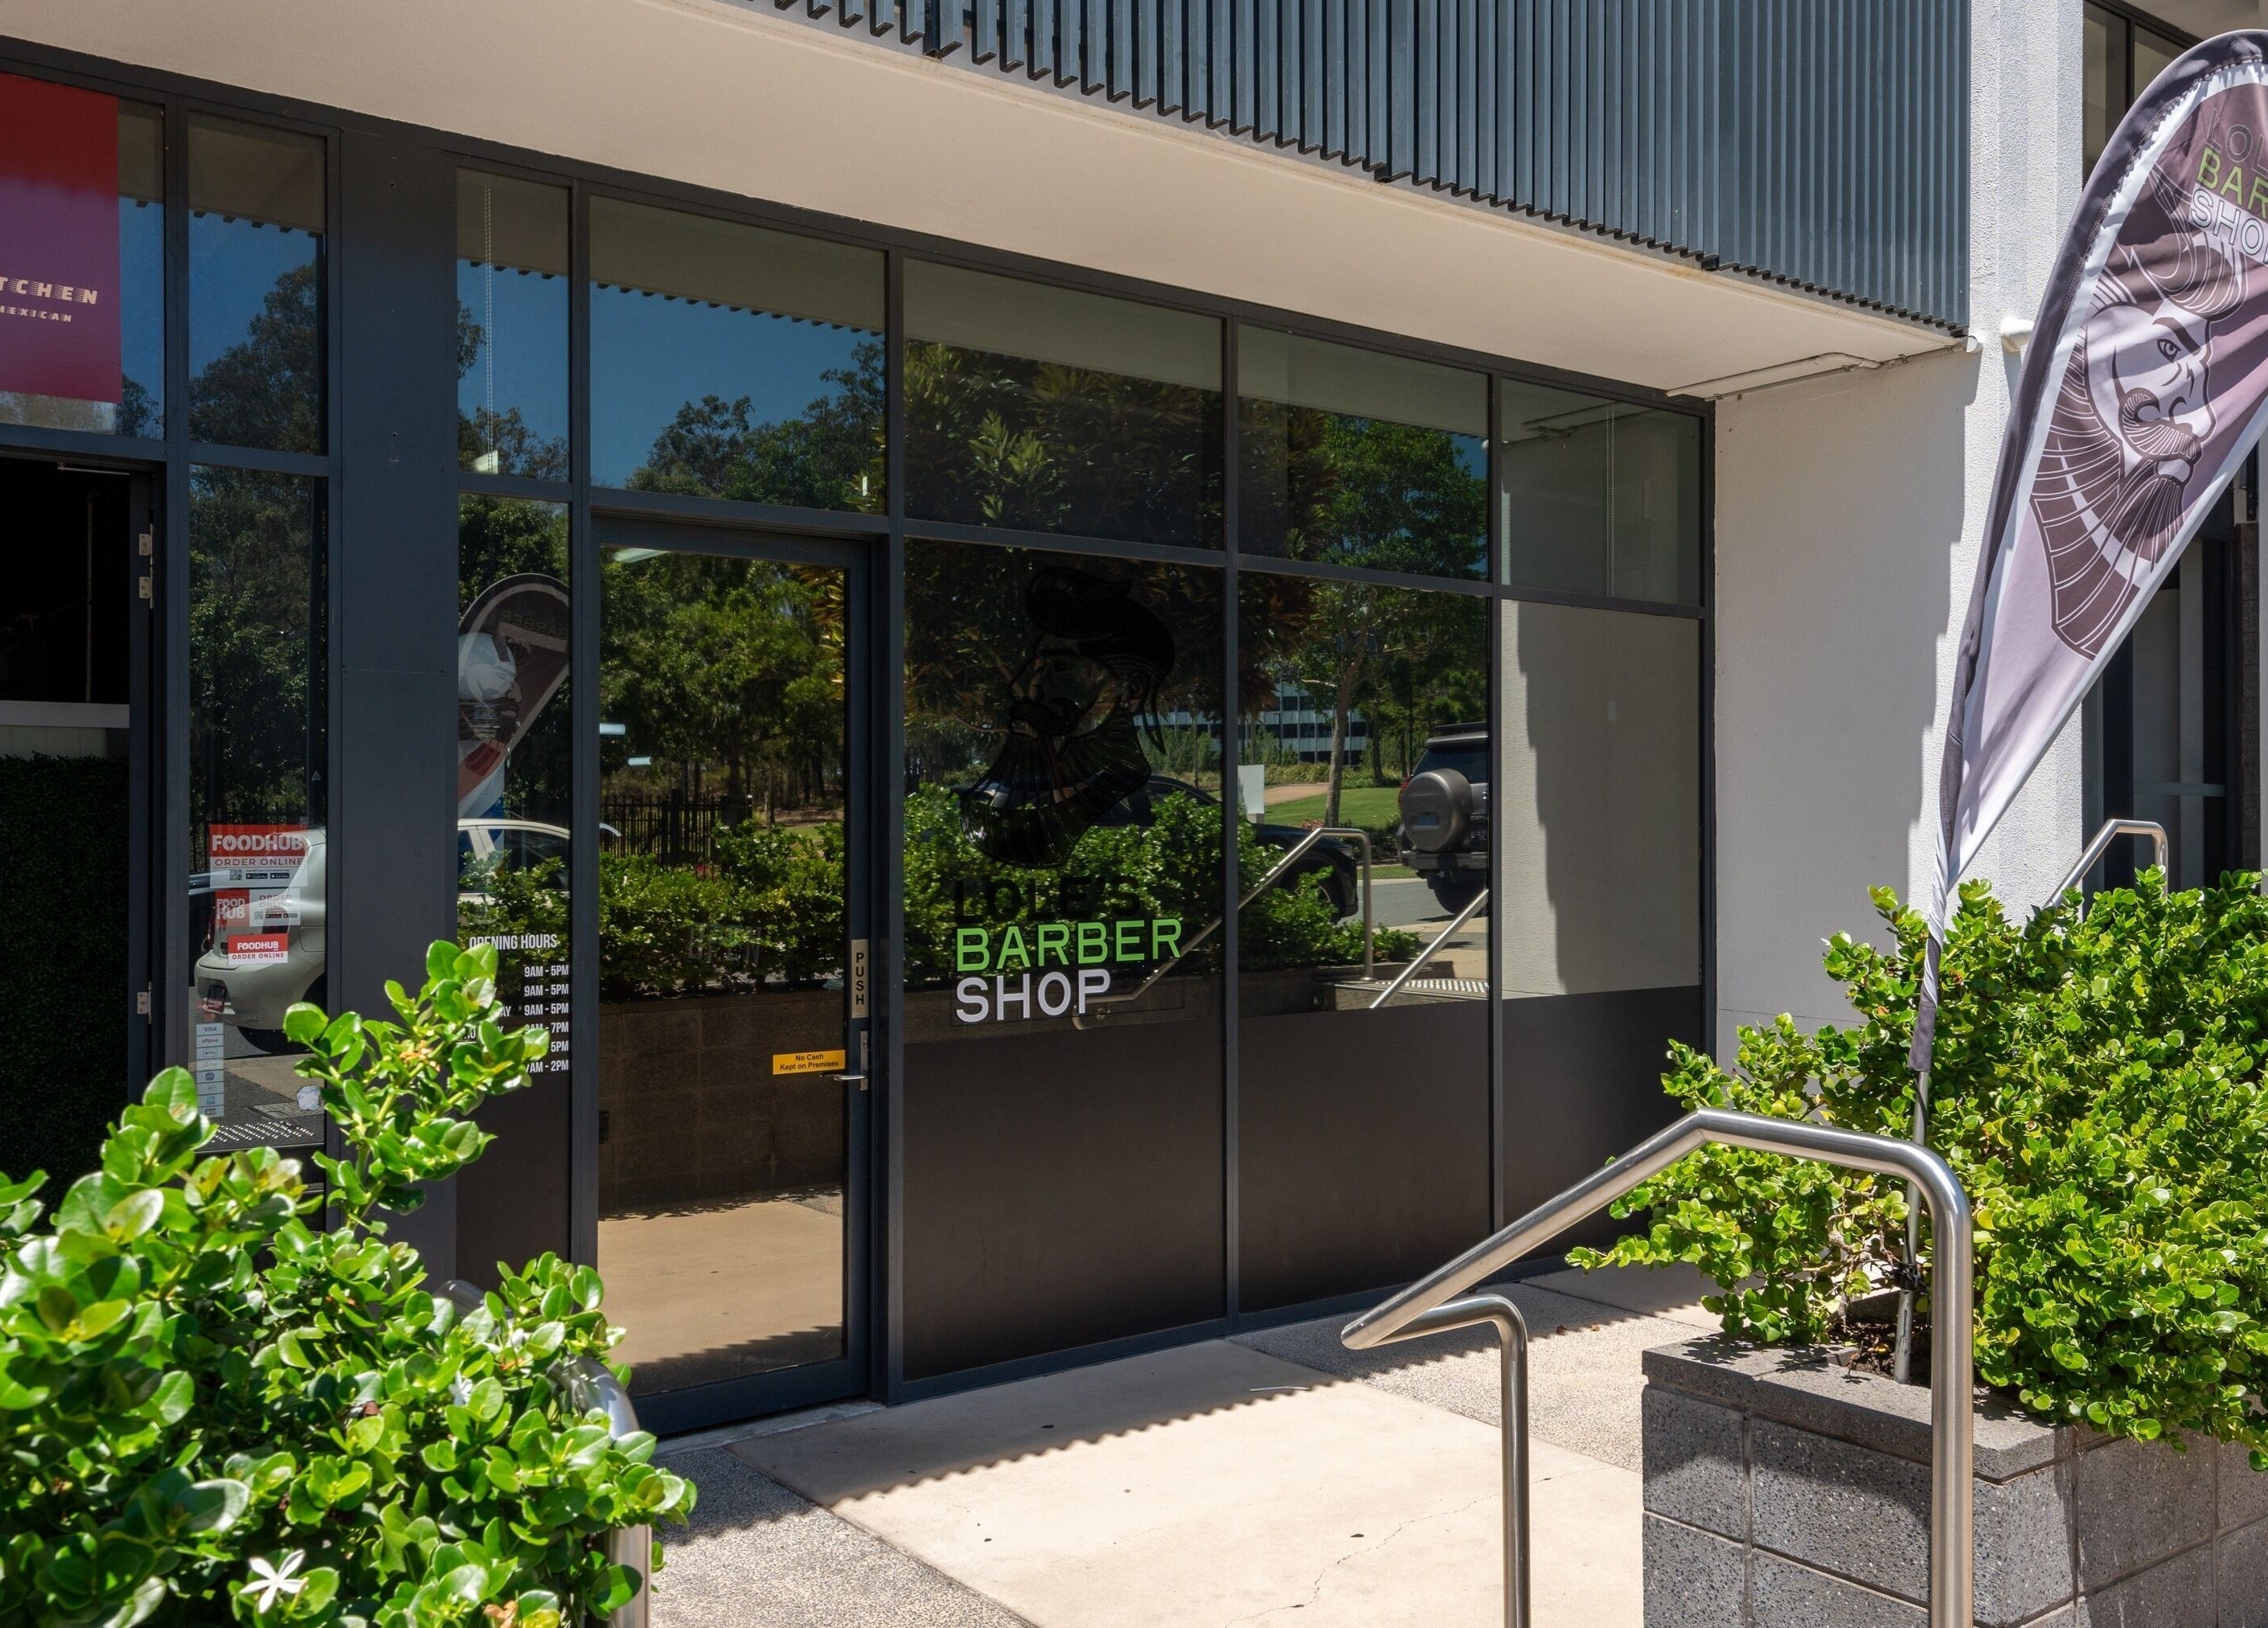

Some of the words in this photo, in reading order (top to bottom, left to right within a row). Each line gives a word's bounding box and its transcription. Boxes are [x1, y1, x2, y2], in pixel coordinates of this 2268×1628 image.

[2190, 187, 2268, 265] SHO
[212, 835, 303, 851] FOODHUB
[215, 858, 256, 867] ORDER
[260, 858, 303, 866] ONLINE
[216, 898, 246, 908] FOOD
[216, 907, 245, 920] HUB
[237, 941, 279, 951] FOODHUB
[520, 933, 557, 949] HOURS
[957, 918, 1183, 972] BARBER
[524, 966, 543, 978] 9AM
[551, 965, 569, 976] 5PM
[855, 952, 864, 1005] PUSH
[524, 985, 543, 997] 9AM
[551, 983, 569, 995] 5PM
[956, 969, 1111, 1023] SHOP
[524, 1004, 543, 1016] 9AM
[551, 1003, 569, 1015] 5PM
[551, 1022, 569, 1033] 7PM
[551, 1040, 569, 1052] 5PM
[806, 1052, 824, 1060] Cash
[551, 1060, 569, 1072] 2PM
[780, 1063, 796, 1071] Kept
[808, 1060, 839, 1068] Premises
